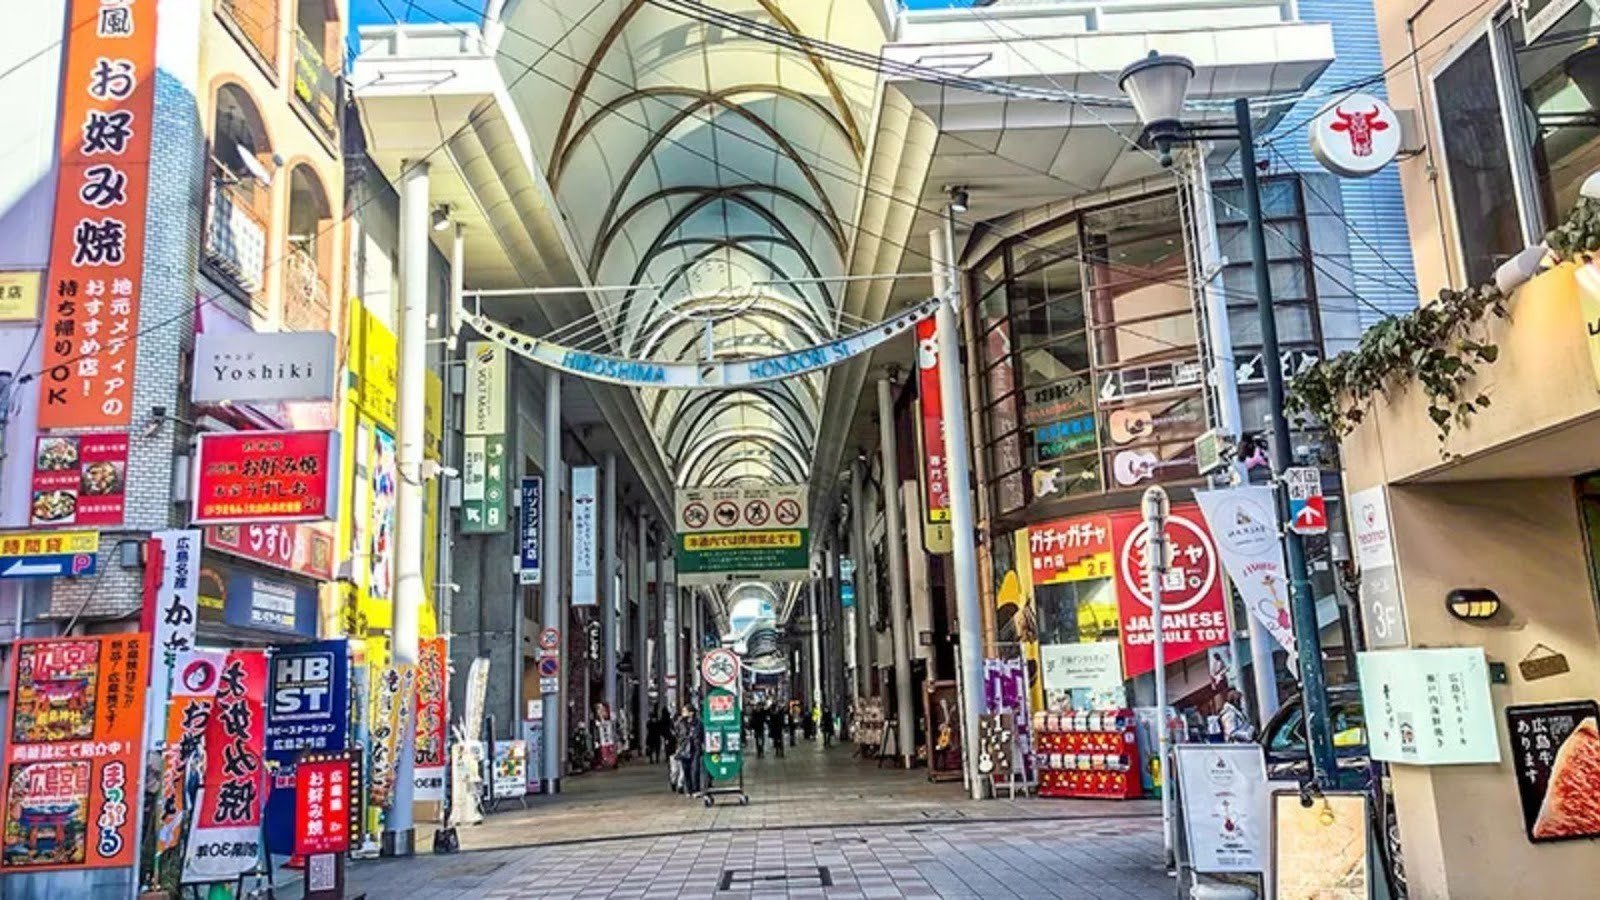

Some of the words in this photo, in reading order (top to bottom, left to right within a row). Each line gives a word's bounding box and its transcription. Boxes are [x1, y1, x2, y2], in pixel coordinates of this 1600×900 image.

[48, 280, 78, 405] 持ち帰りOK
[102, 278, 132, 415] 地元メディアの
[213, 362, 312, 382] Yoshiki
[562, 350, 666, 383] HIROSHIMA
[241, 455, 319, 477] お好み焼
[1030, 522, 1106, 553] ガチャガチャ
[1127, 630, 1192, 645] CAPULE
[1195, 627, 1226, 642] TOY
[1373, 601, 1396, 639] 3F
[277, 658, 330, 684] HB
[275, 687, 329, 714] ST
[1516, 719, 1539, 785] あります
[1531, 716, 1553, 767] 広島牛
